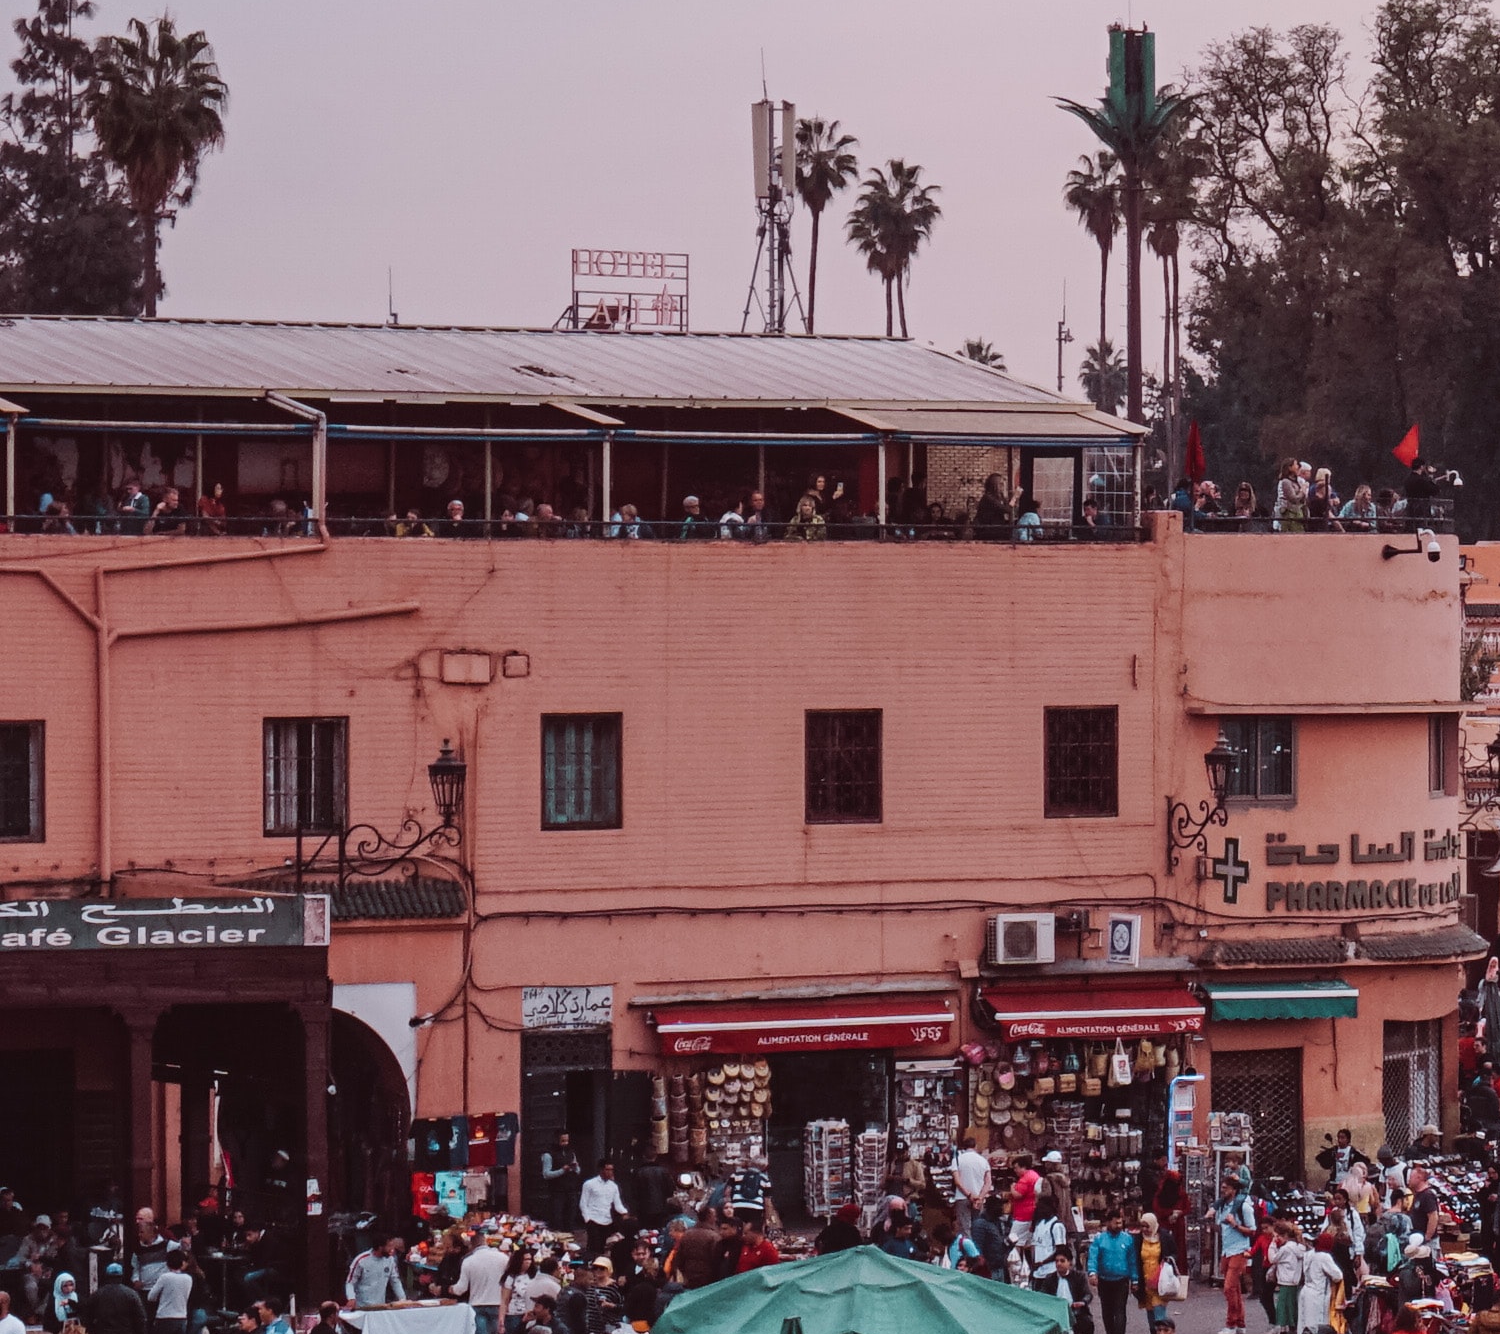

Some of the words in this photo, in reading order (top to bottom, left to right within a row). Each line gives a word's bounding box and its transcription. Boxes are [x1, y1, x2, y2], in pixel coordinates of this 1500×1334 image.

[573, 249, 676, 278] HOTEL
[590, 297, 641, 325] ALI
[1265, 878, 1417, 912] PHARMACIE
[1419, 882, 1438, 908] DE
[81, 897, 275, 924] السطح
[1, 927, 73, 947] afé
[96, 926, 266, 946] Glacier
[757, 1034, 821, 1045] ALIMENTATION
[823, 1031, 869, 1042] GÉNÉRALE
[1056, 1026, 1114, 1035] ALIMENTATION
[1116, 1023, 1160, 1033] GÉNÉRALE
